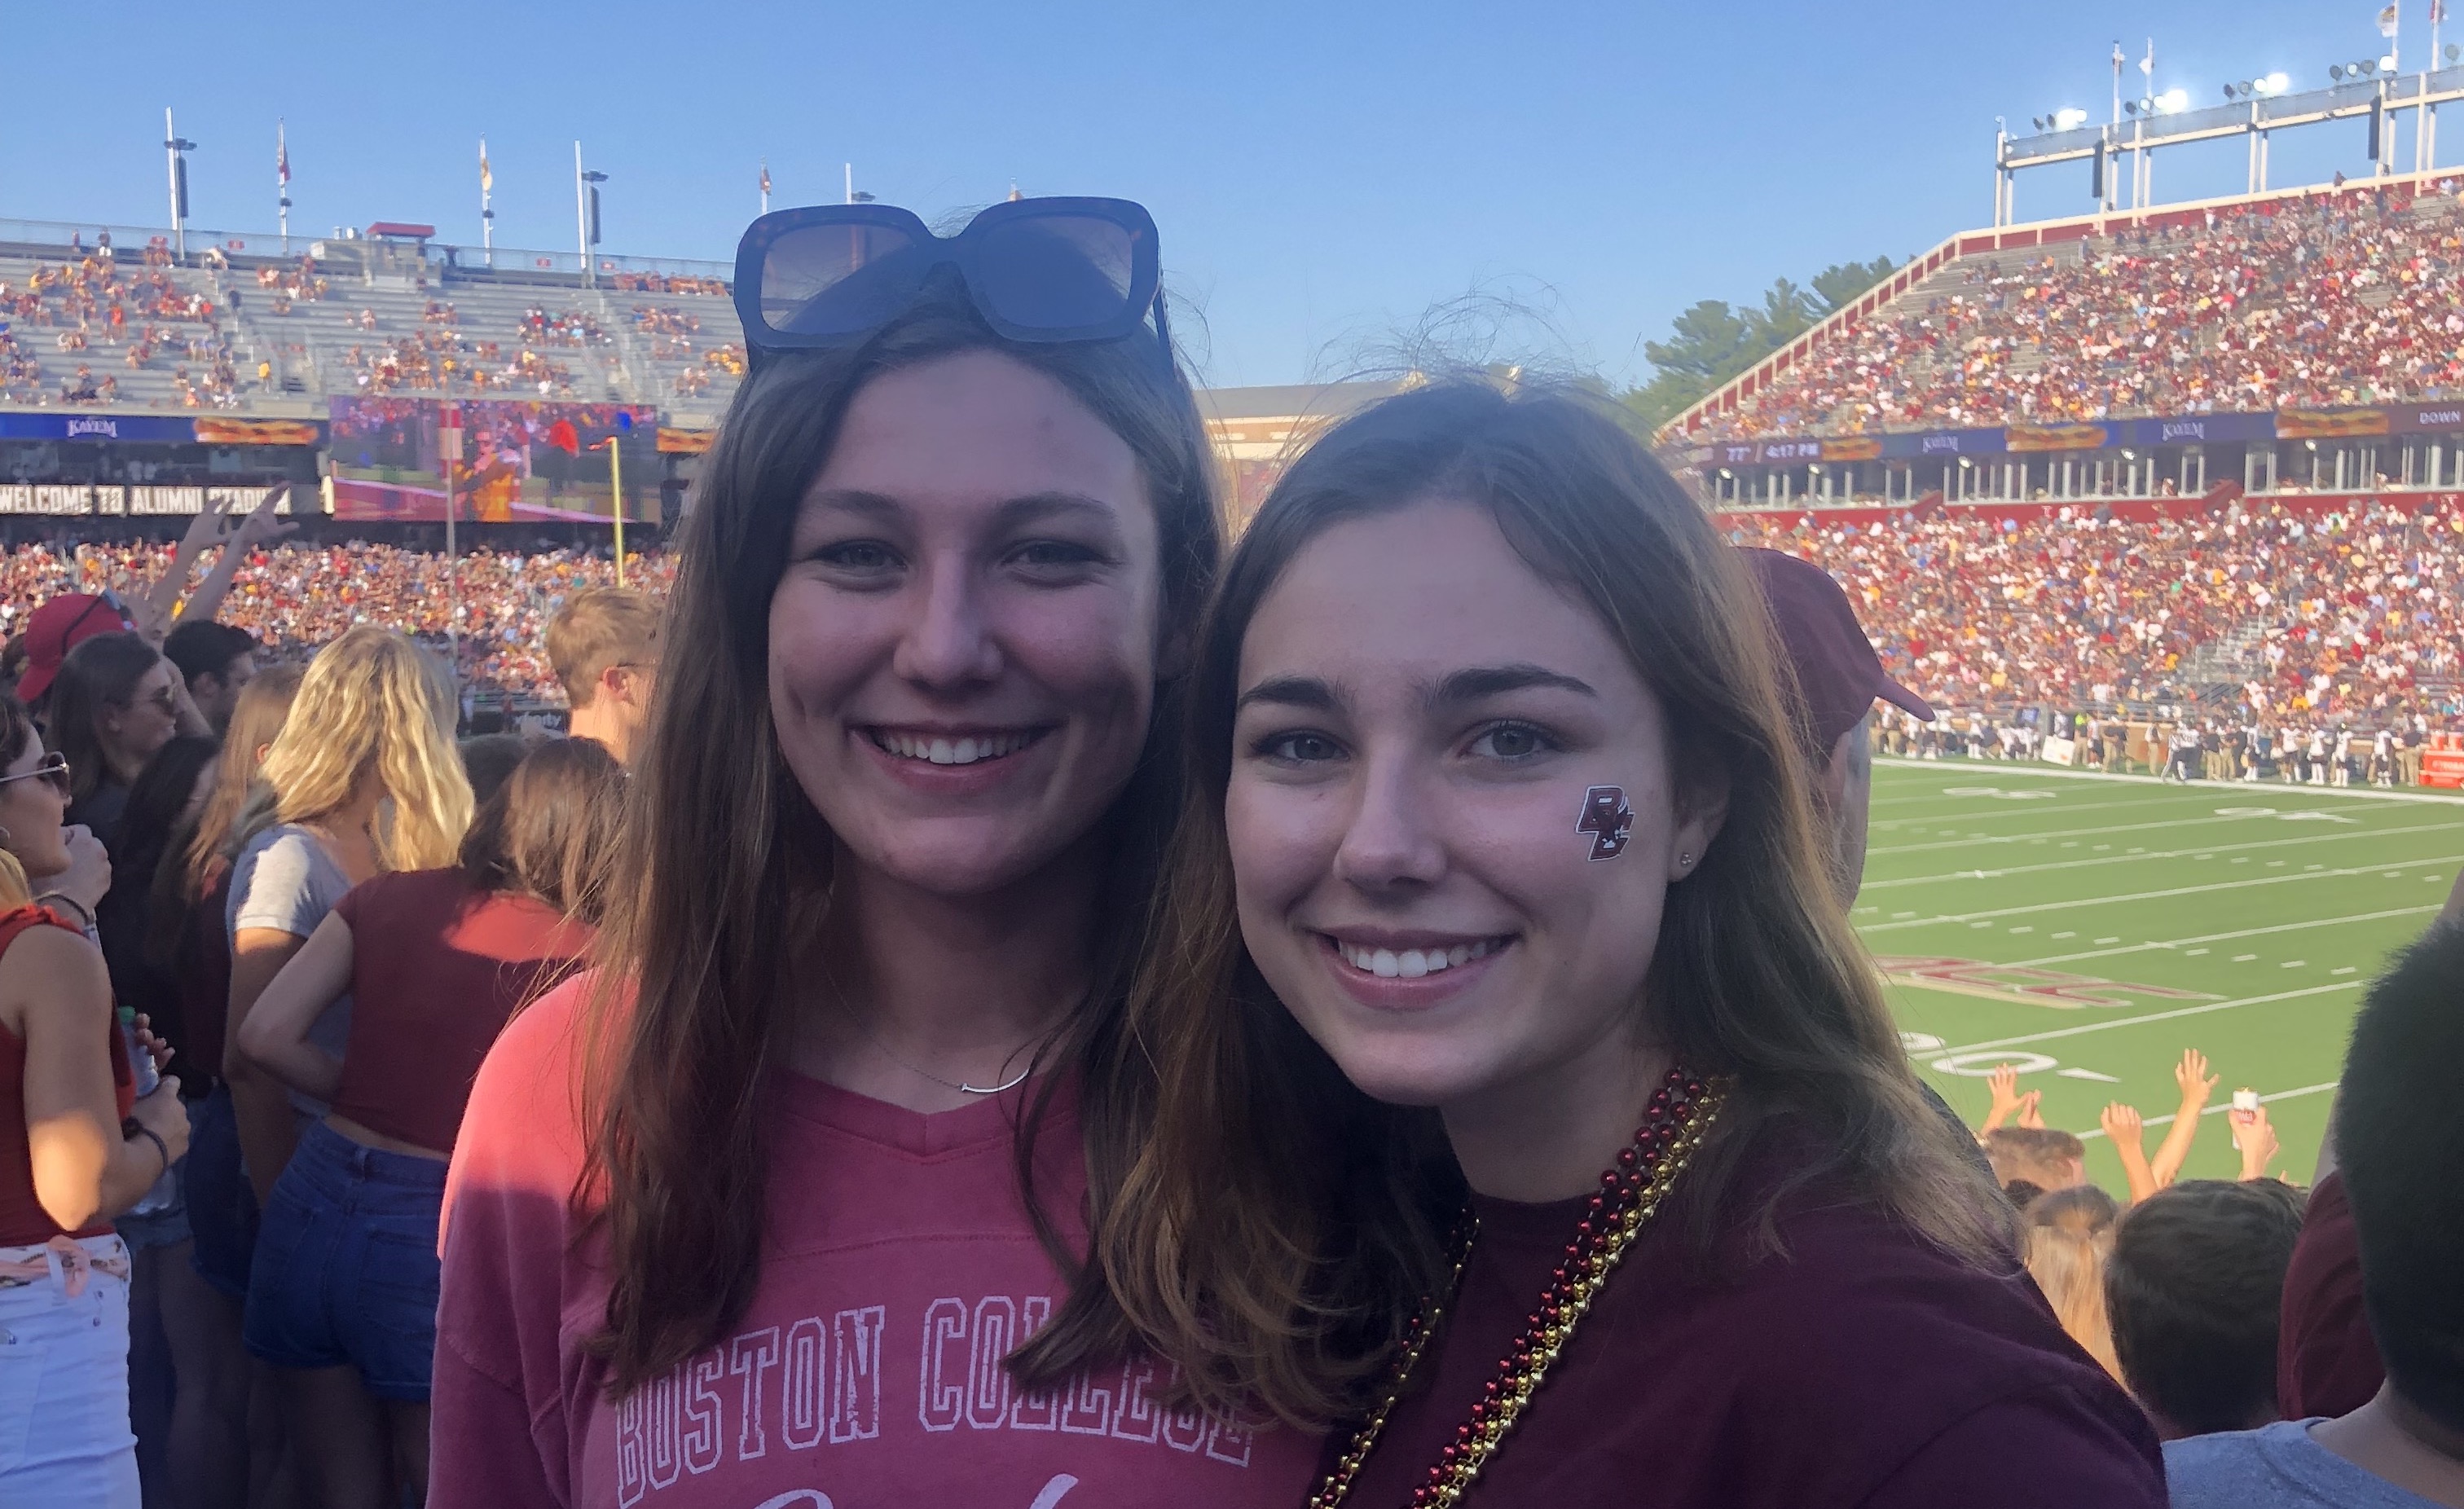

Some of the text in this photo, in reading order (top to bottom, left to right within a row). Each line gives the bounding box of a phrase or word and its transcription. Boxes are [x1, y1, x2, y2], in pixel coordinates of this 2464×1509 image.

[2419, 411, 2462, 425] DOWN
[0, 486, 92, 513] WELCOME
[95, 486, 125, 513] TO
[130, 487, 203, 514] ALUMNI
[615, 1304, 886, 1509] BOSTON
